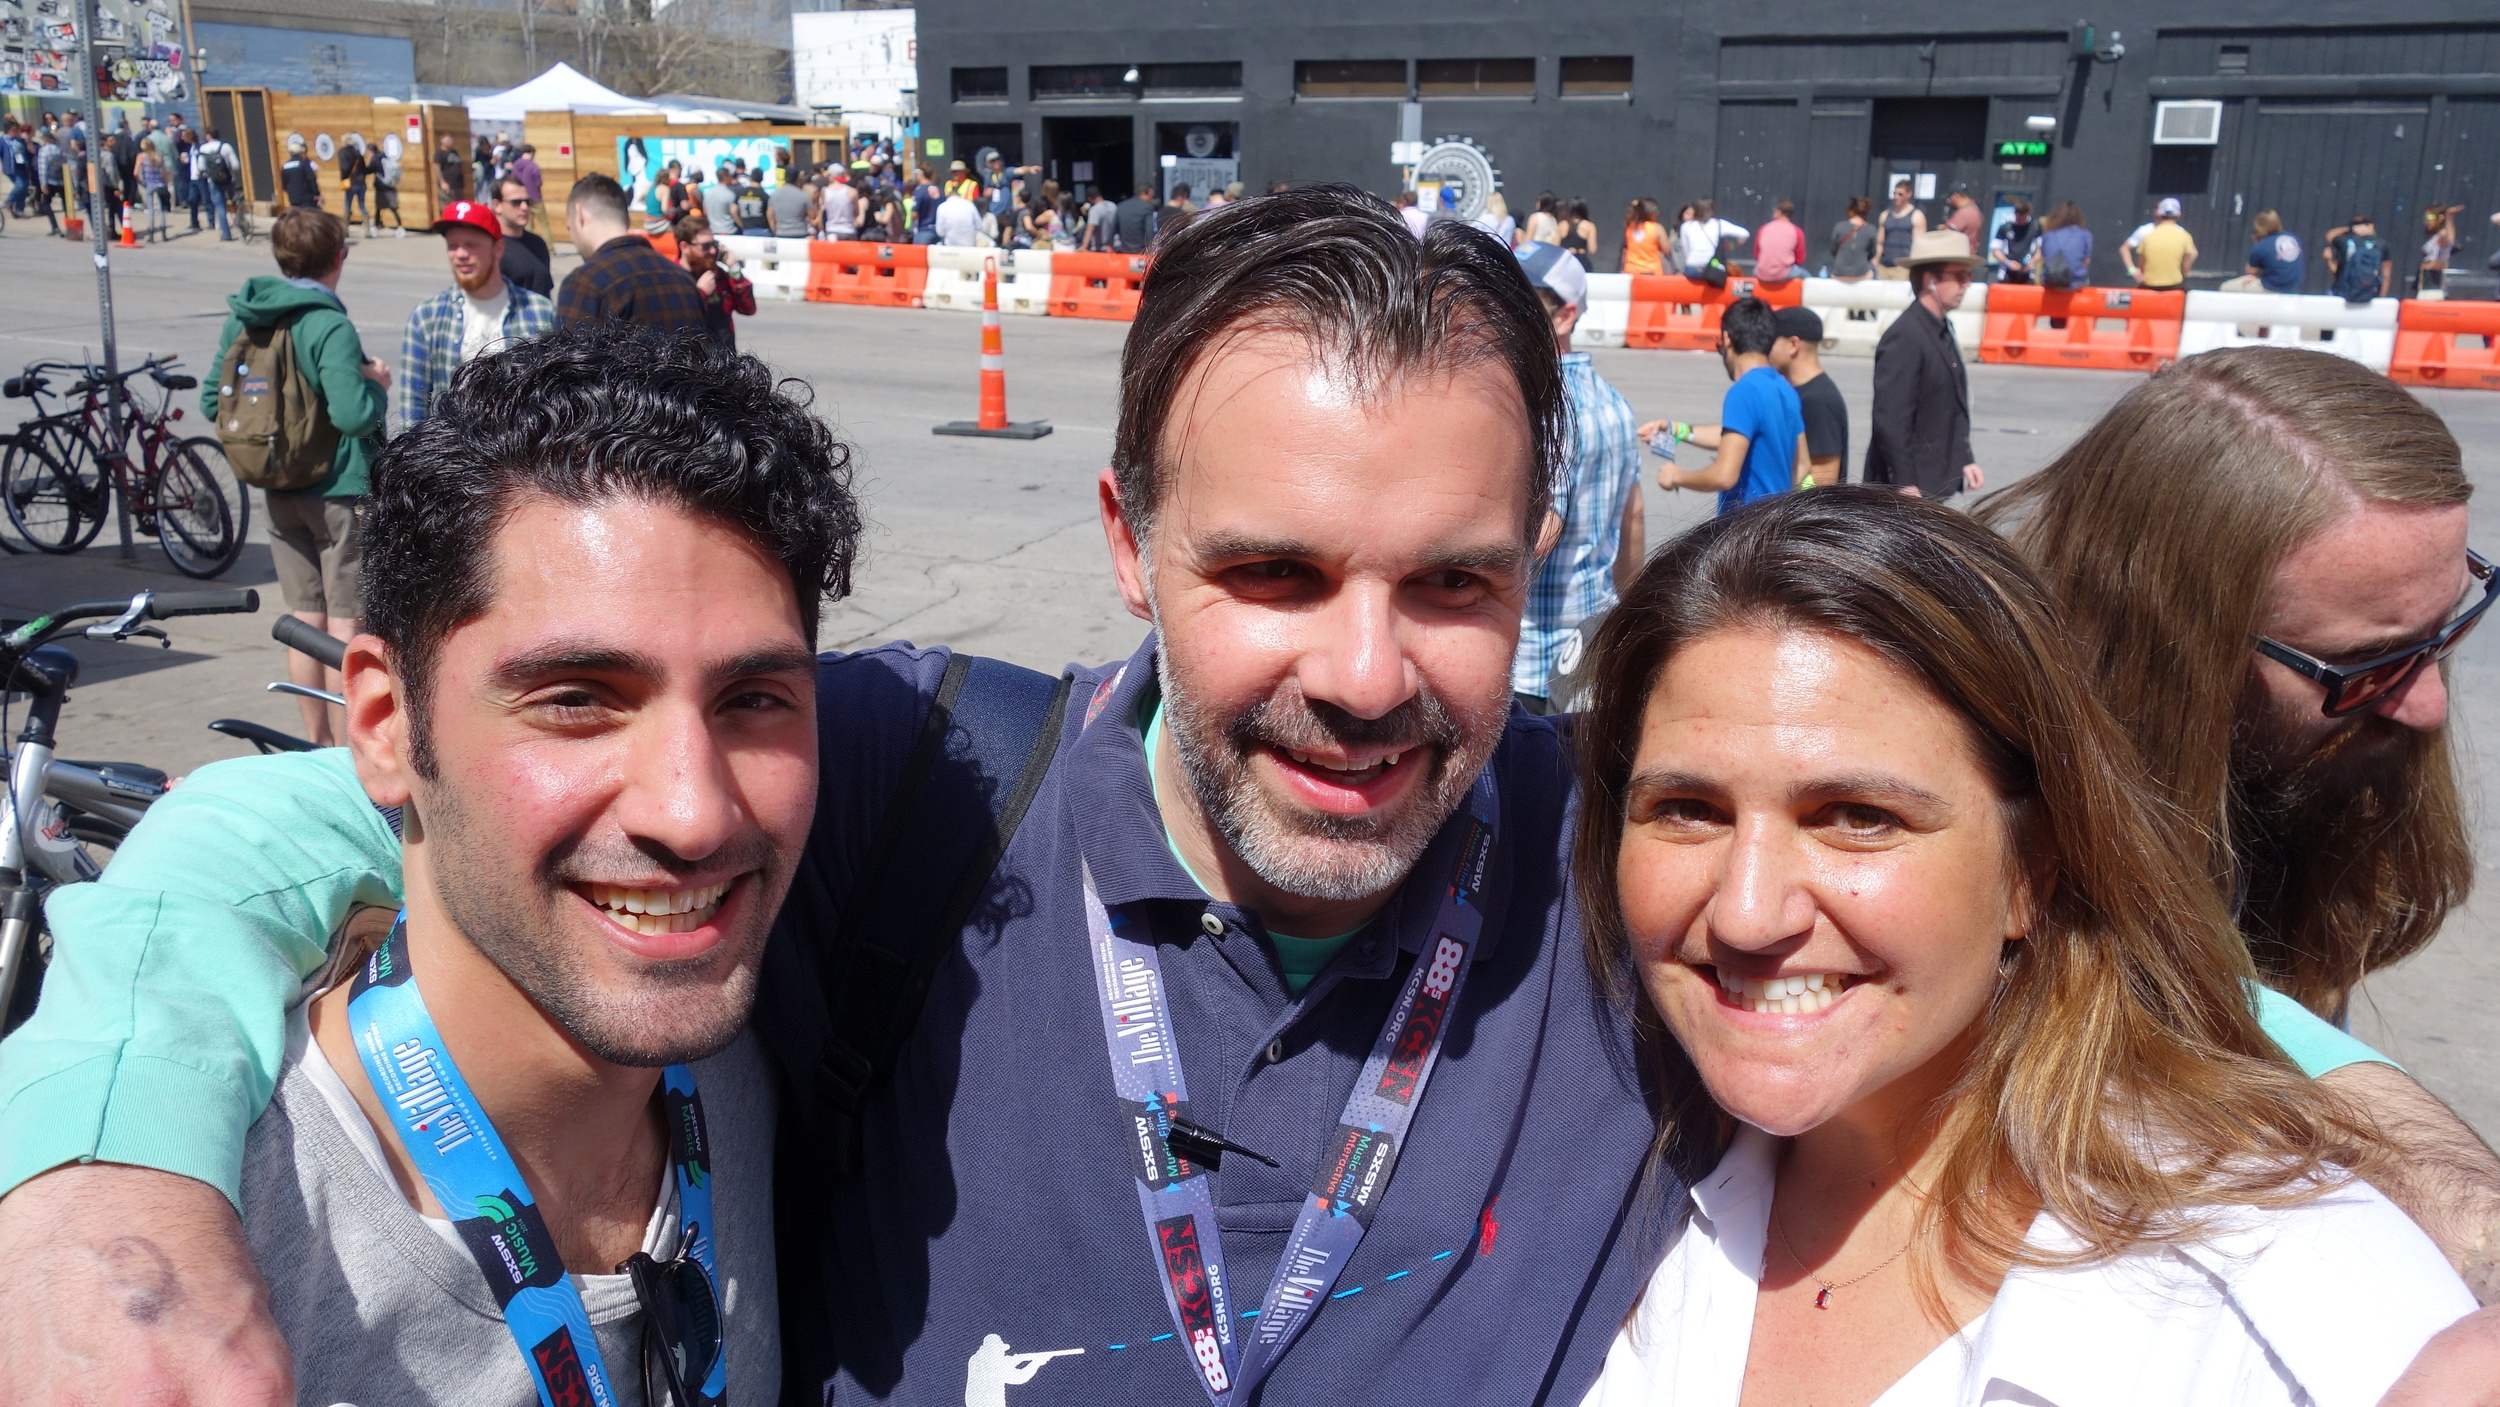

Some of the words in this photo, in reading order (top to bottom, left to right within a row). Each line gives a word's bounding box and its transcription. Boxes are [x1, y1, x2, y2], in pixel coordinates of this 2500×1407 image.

[2000, 142, 2047, 155] ATM
[1456, 823, 1478, 882] Interactive
[1467, 827, 1482, 860] Music
[1472, 833, 1491, 893] SXSW
[1460, 862, 1471, 885] Film
[1112, 957, 1156, 1038] Village
[1386, 967, 1425, 1043] KCSN.ORG
[373, 1054, 396, 1094] RECORDING
[380, 1051, 403, 1091] RECORDING
[1130, 1031, 1164, 1068] The
[1379, 995, 1443, 1104] KCSN
[392, 1037, 455, 1132] Village
[434, 1112, 474, 1157] The
[435, 1061, 498, 1161] villagestudios.com
[682, 1105, 695, 1156] Music
[688, 1103, 701, 1151] SXSW
[1147, 1117, 1155, 1131] 2014
[1157, 1111, 1168, 1138] Film
[1135, 1116, 1158, 1181] SXSW
[1327, 1131, 1361, 1194] Interactive
[1349, 1135, 1372, 1171] Music
[1337, 1173, 1355, 1197] Film
[1350, 1184, 1360, 1199] 2014
[1357, 1142, 1388, 1206] SXSW
[505, 1222, 538, 1278] Music
[517, 1218, 528, 1233] 2014
[491, 1234, 523, 1284] SXSW
[1161, 1215, 1210, 1331] KCSN
[1291, 1246, 1332, 1276] The
[1208, 1264, 1231, 1345] KCSN.ORG
[1259, 1276, 1325, 1345] Village
